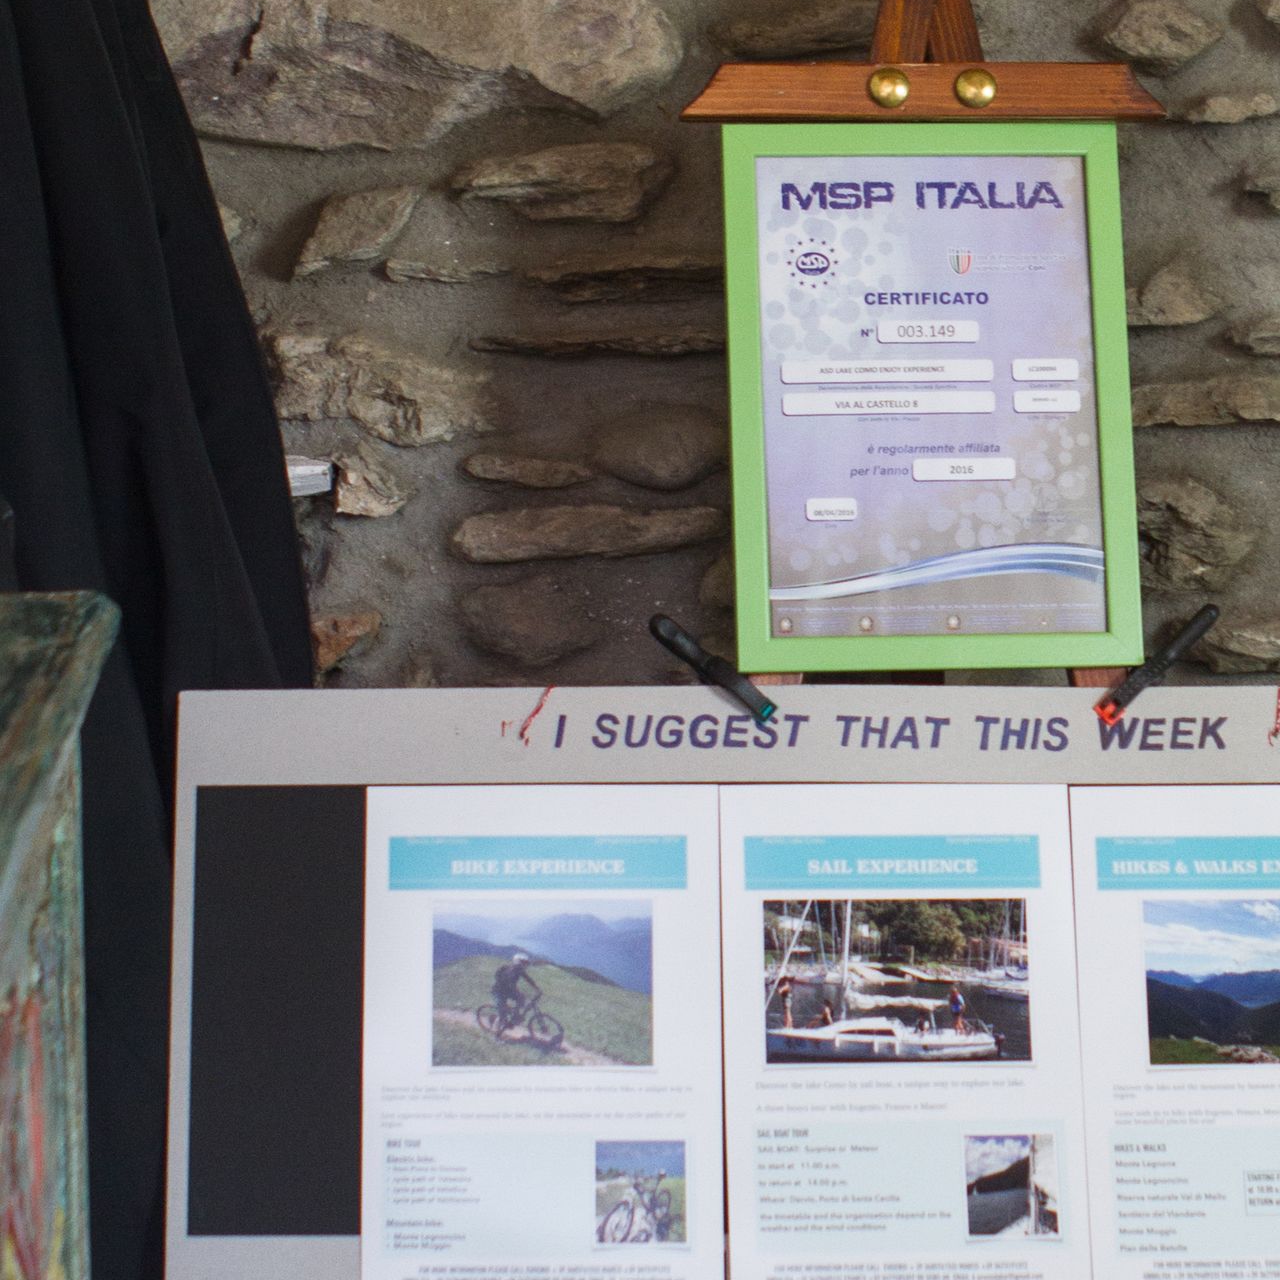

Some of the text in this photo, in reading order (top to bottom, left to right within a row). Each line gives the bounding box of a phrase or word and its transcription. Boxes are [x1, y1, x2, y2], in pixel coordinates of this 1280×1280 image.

[781, 181, 1063, 210] MSP ITALIA
[864, 292, 989, 305] CERTIFICATO
[897, 324, 955, 338] 003.149
[835, 401, 850, 409] VIA
[866, 400, 910, 408] CASTELLO
[878, 443, 955, 457] regolarmente
[958, 442, 1001, 454] affiliata
[850, 465, 974, 478] per l'anno 2016
[554, 714, 1228, 751] I SUGGEST THAT THIS WEEK
[452, 859, 624, 875] BIKE EXPERIENCE
[807, 859, 978, 875] SAIL EXPERIENCE
[1112, 860, 1170, 875] HIKES
[1175, 860, 1187, 874] &
[1193, 859, 1256, 874] WALKS
